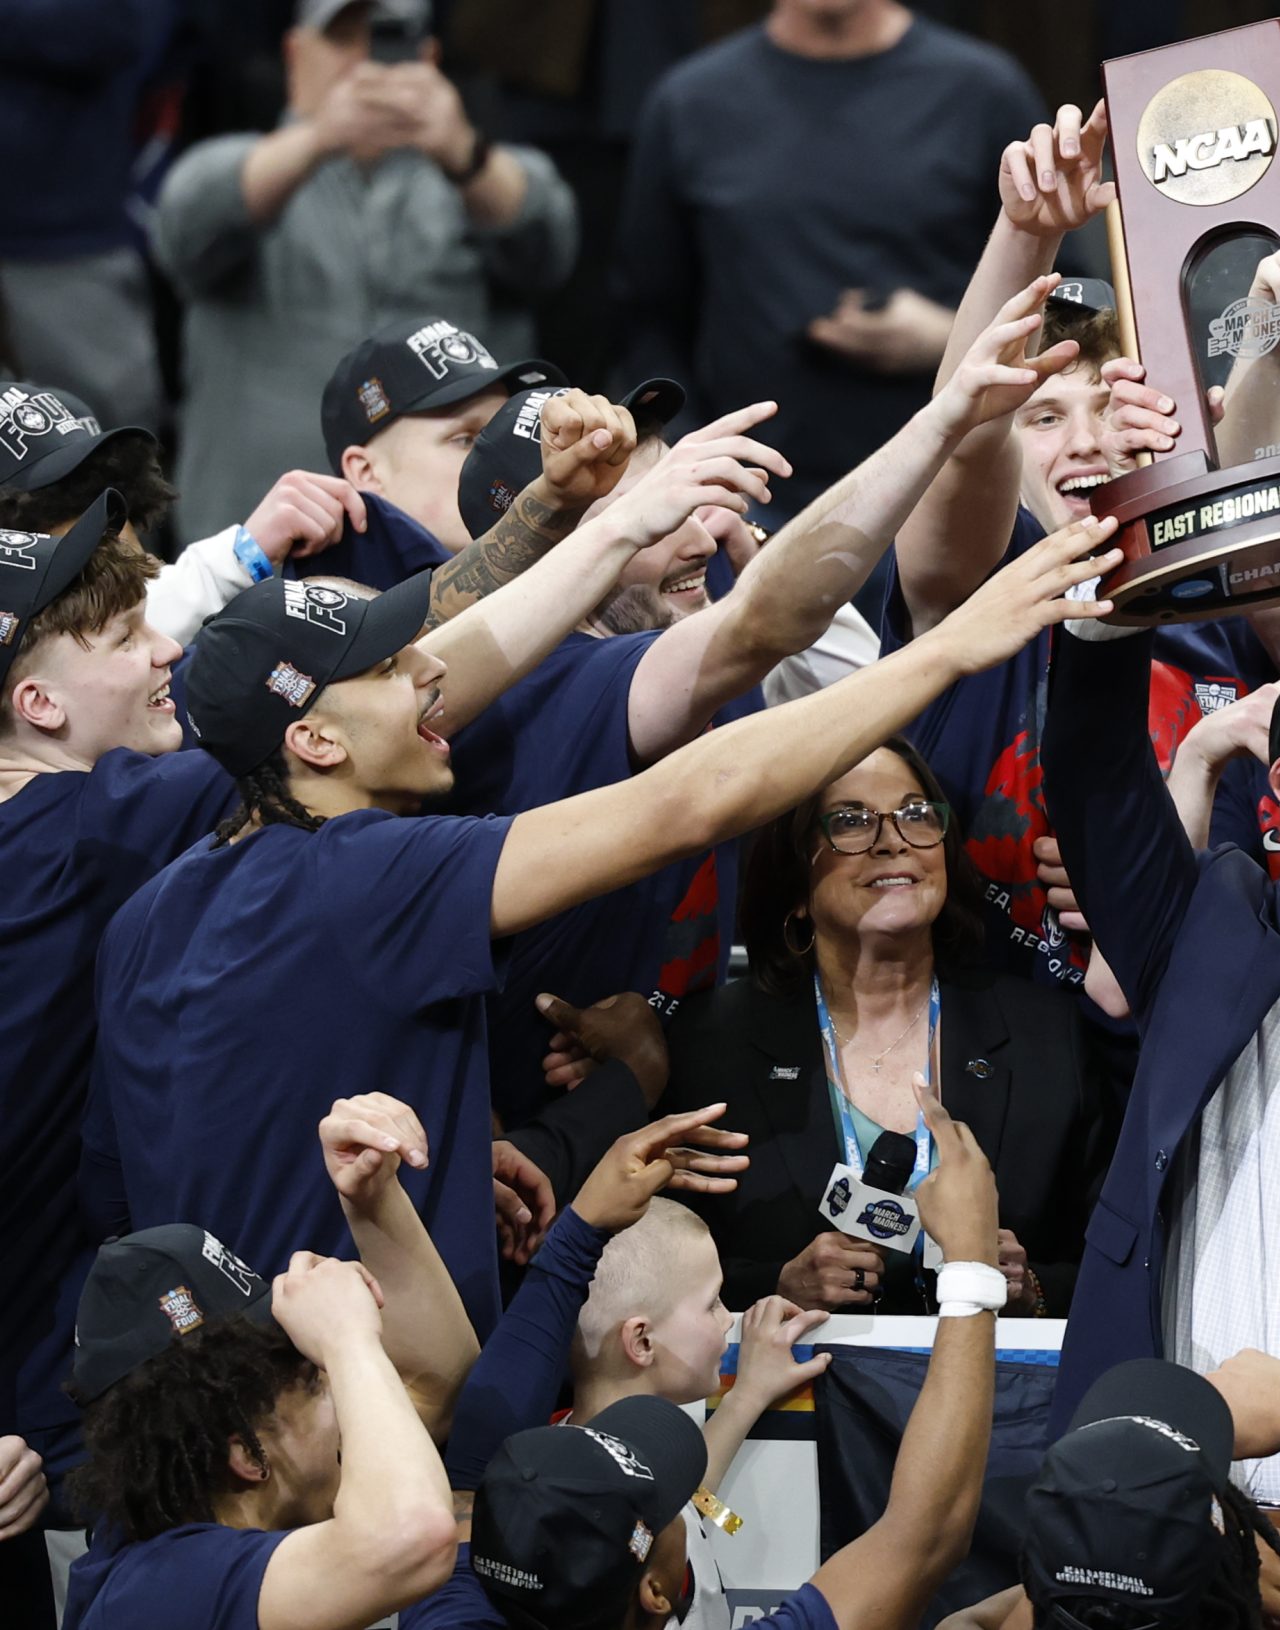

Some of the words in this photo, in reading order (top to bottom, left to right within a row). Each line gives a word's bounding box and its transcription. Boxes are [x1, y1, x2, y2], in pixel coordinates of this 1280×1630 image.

[1152, 119, 1275, 184] NCAA
[407, 319, 459, 353] FINAL
[0, 387, 29, 421] NAL
[512, 391, 552, 439] FINAL
[1153, 510, 1197, 546] EAST
[284, 579, 309, 621] FINAL
[273, 667, 295, 693] FINAL
[289, 678, 311, 704] FOUR
[916, 1137, 929, 1172] NCAA
[872, 1215, 909, 1233] MADNESS
[873, 1206, 900, 1221] MARCH
[164, 1293, 190, 1313] FINAL
[174, 1310, 199, 1329] FOUR
